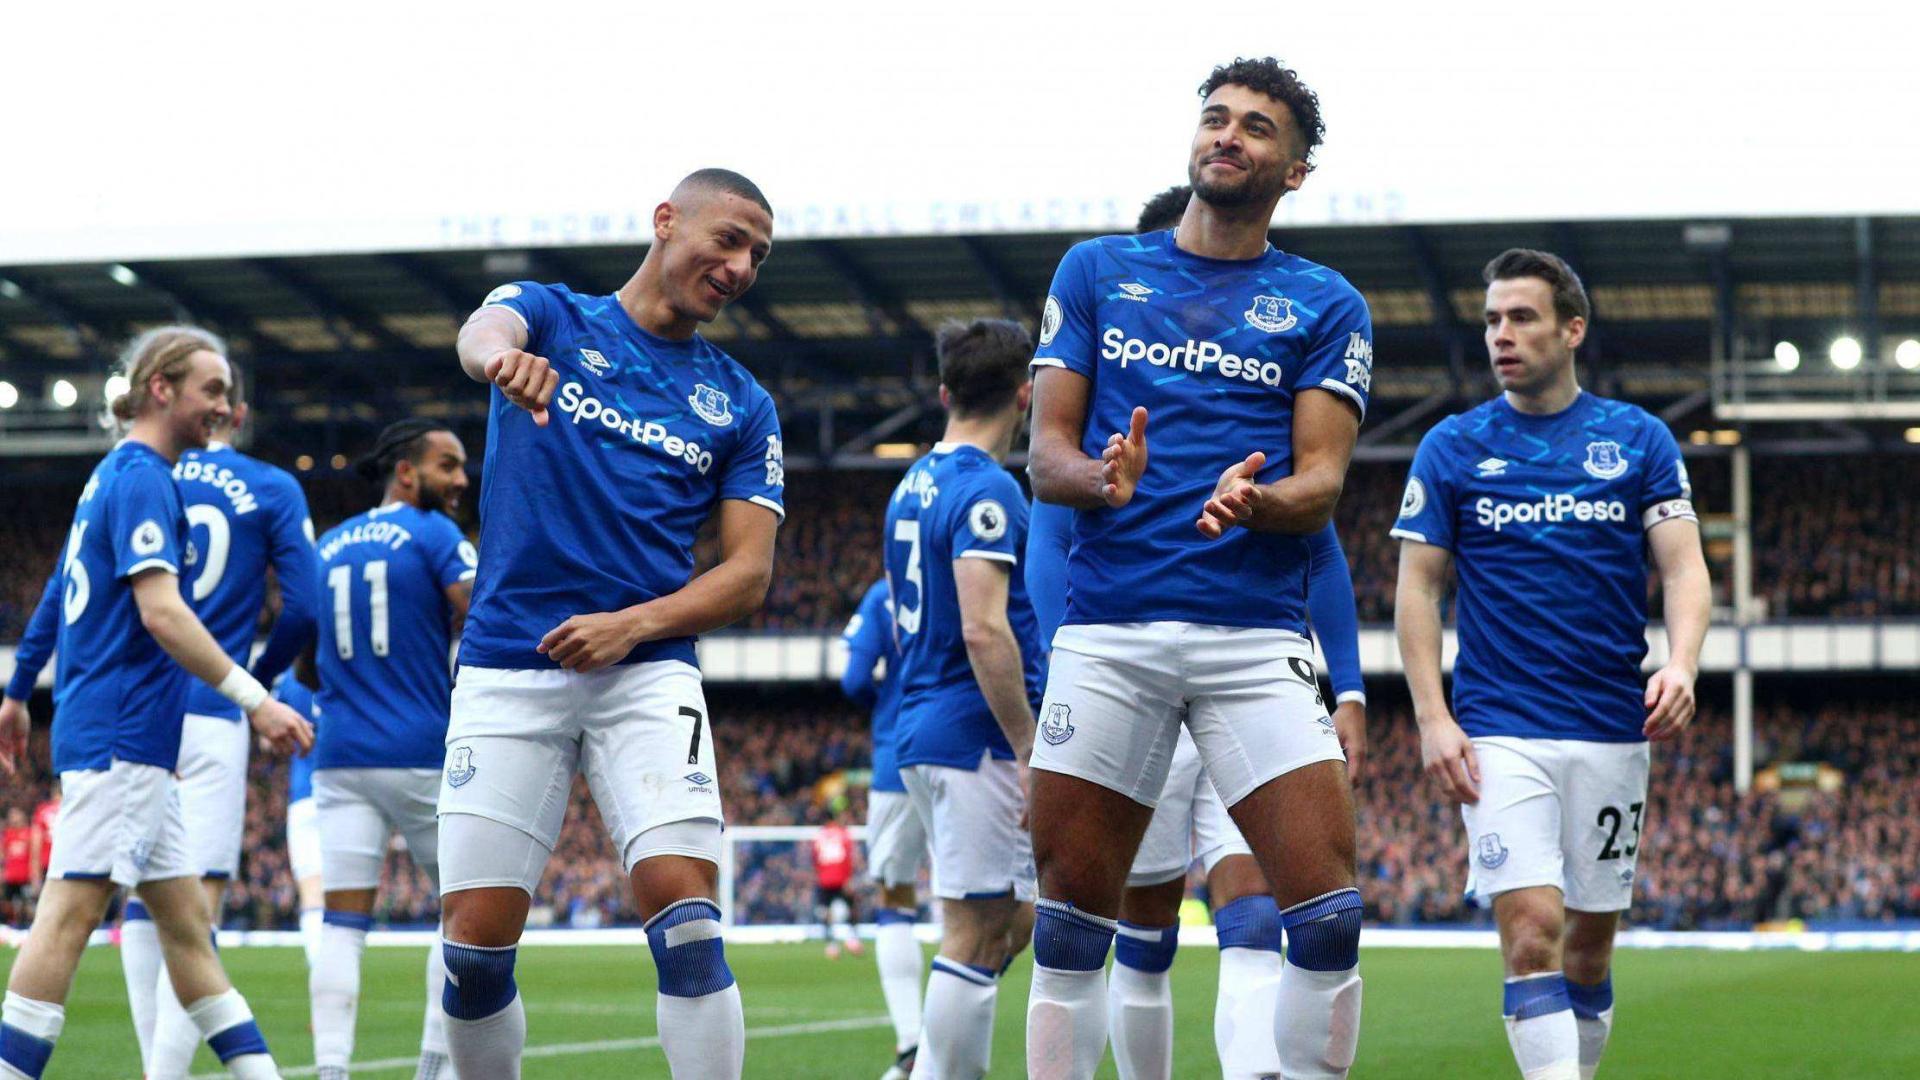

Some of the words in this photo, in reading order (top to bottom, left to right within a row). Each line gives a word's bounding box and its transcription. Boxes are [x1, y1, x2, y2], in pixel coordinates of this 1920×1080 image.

[775, 204, 900, 234] NDALL
[1101, 328, 1282, 387] SportPesa
[557, 382, 713, 475] SportPesa
[171, 461, 259, 516] RDSSON
[1475, 494, 1626, 532] SportPesa
[319, 521, 413, 562] WALCOTT
[894, 518, 923, 635] 3
[327, 558, 390, 661] 11
[678, 705, 702, 765] 7
[1596, 801, 1645, 862] 23
